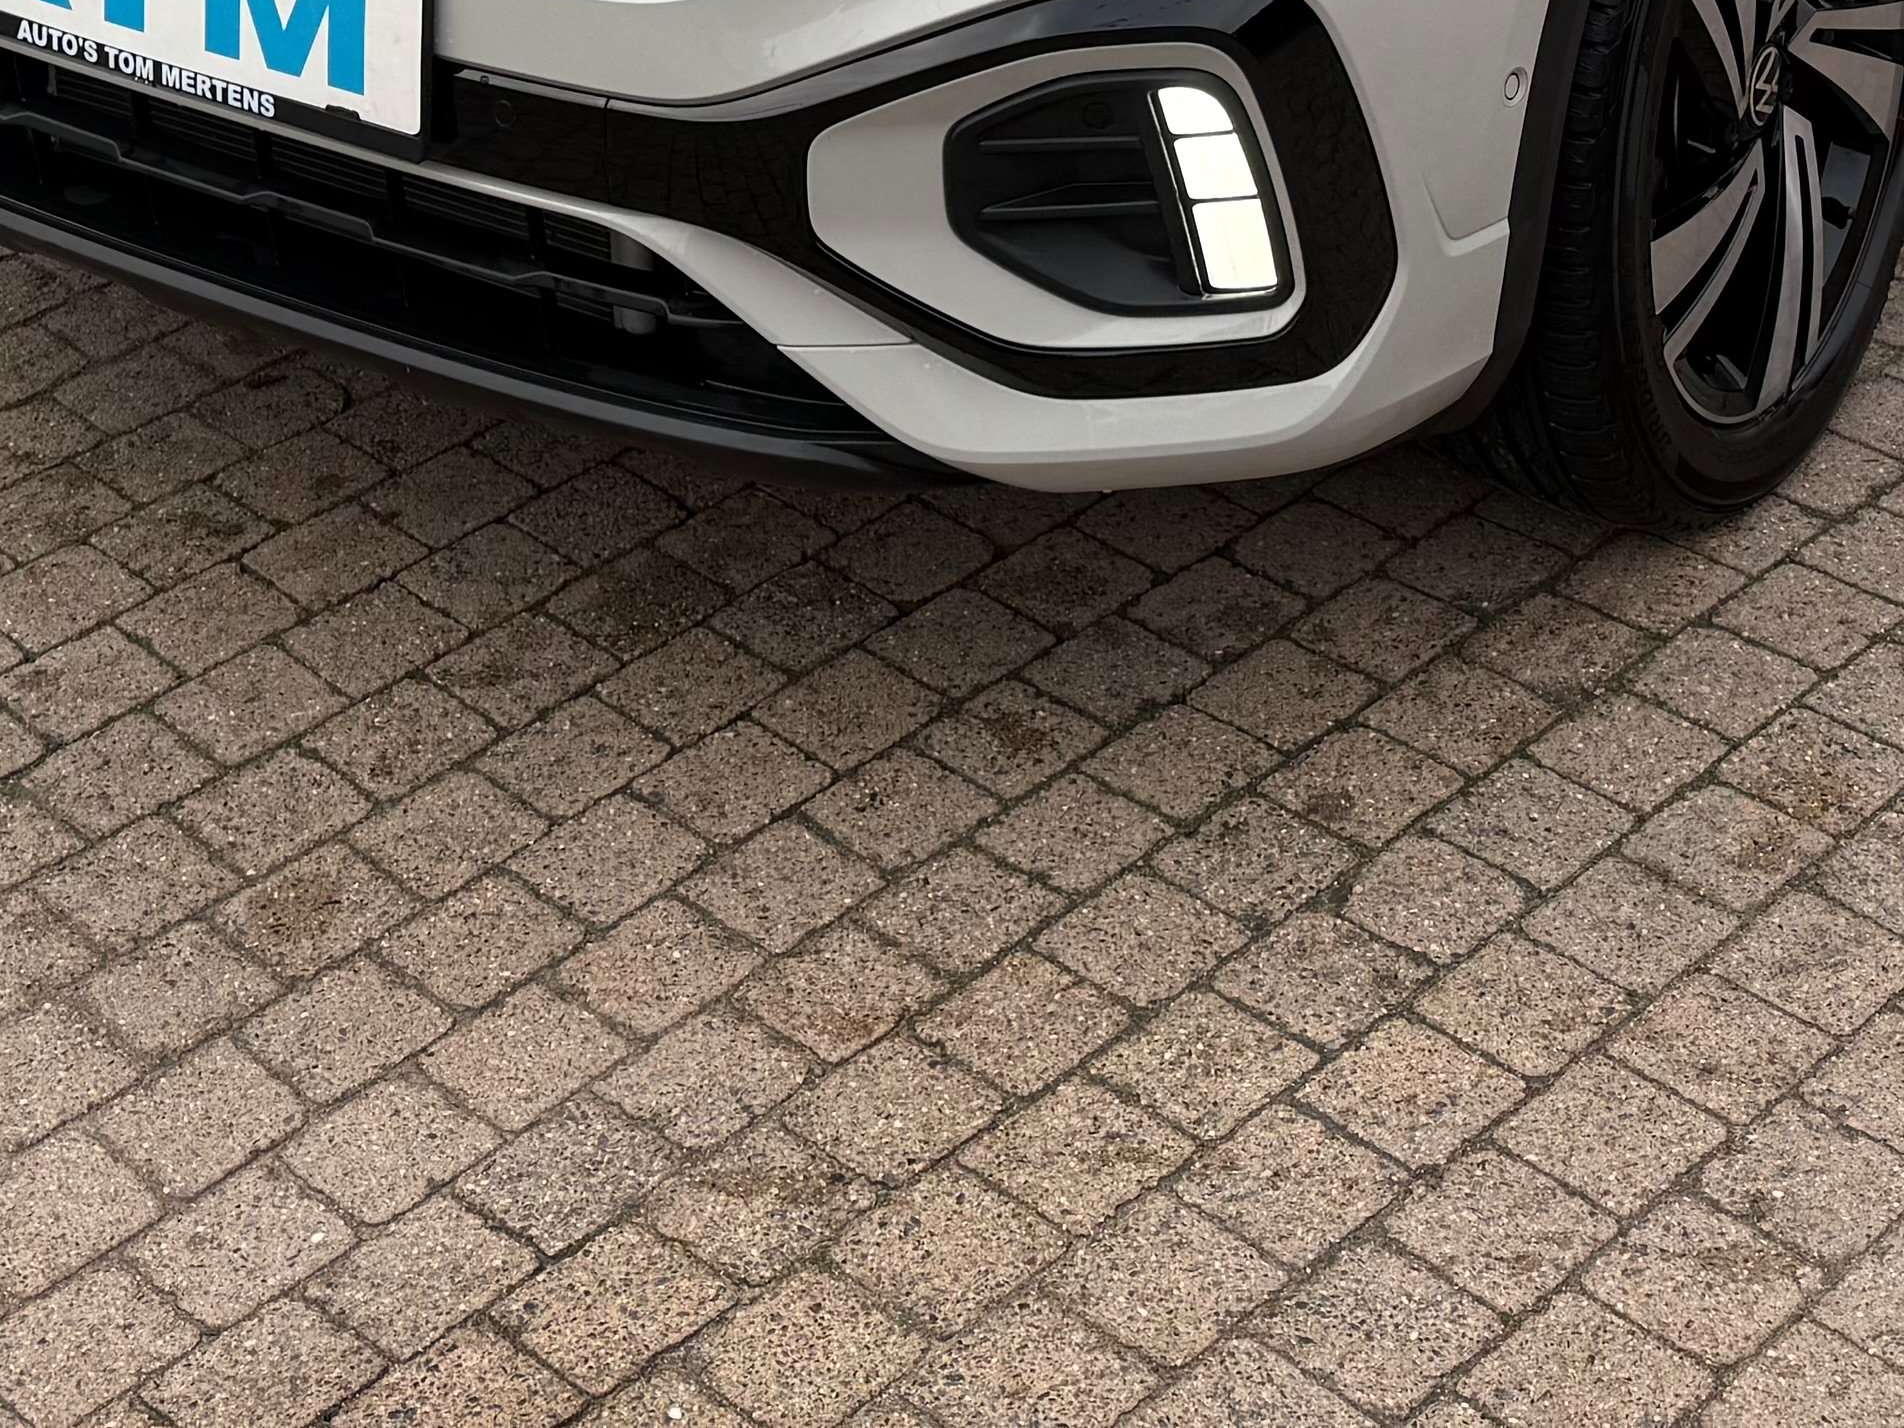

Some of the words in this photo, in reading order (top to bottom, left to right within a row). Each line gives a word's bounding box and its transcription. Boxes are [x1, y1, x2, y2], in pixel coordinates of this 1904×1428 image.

[16, 19, 98, 63] AUTO'S
[104, 46, 154, 81] TOM
[161, 64, 275, 118] MERTENS
